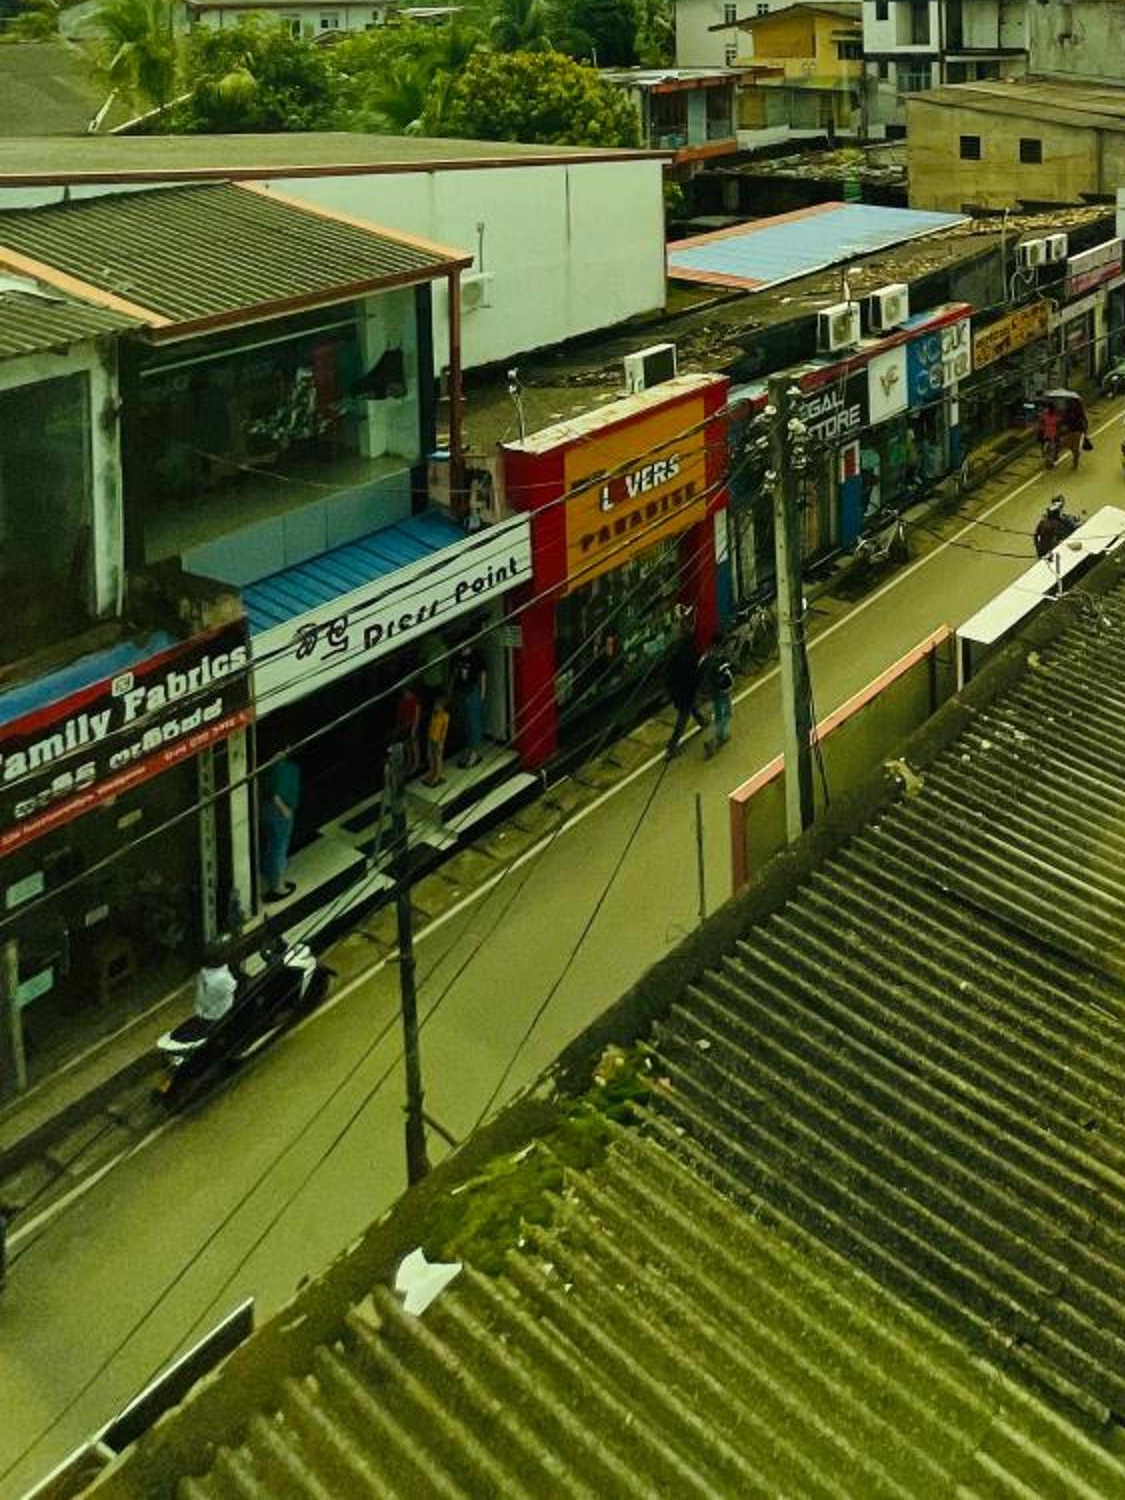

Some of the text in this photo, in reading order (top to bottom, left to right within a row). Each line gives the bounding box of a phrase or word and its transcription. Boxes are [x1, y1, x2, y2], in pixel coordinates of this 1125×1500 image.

[602, 453, 680, 512] LVERS
[454, 556, 518, 604] Point
[0, 708, 113, 782] amily
[123, 645, 248, 723] Fabrics
